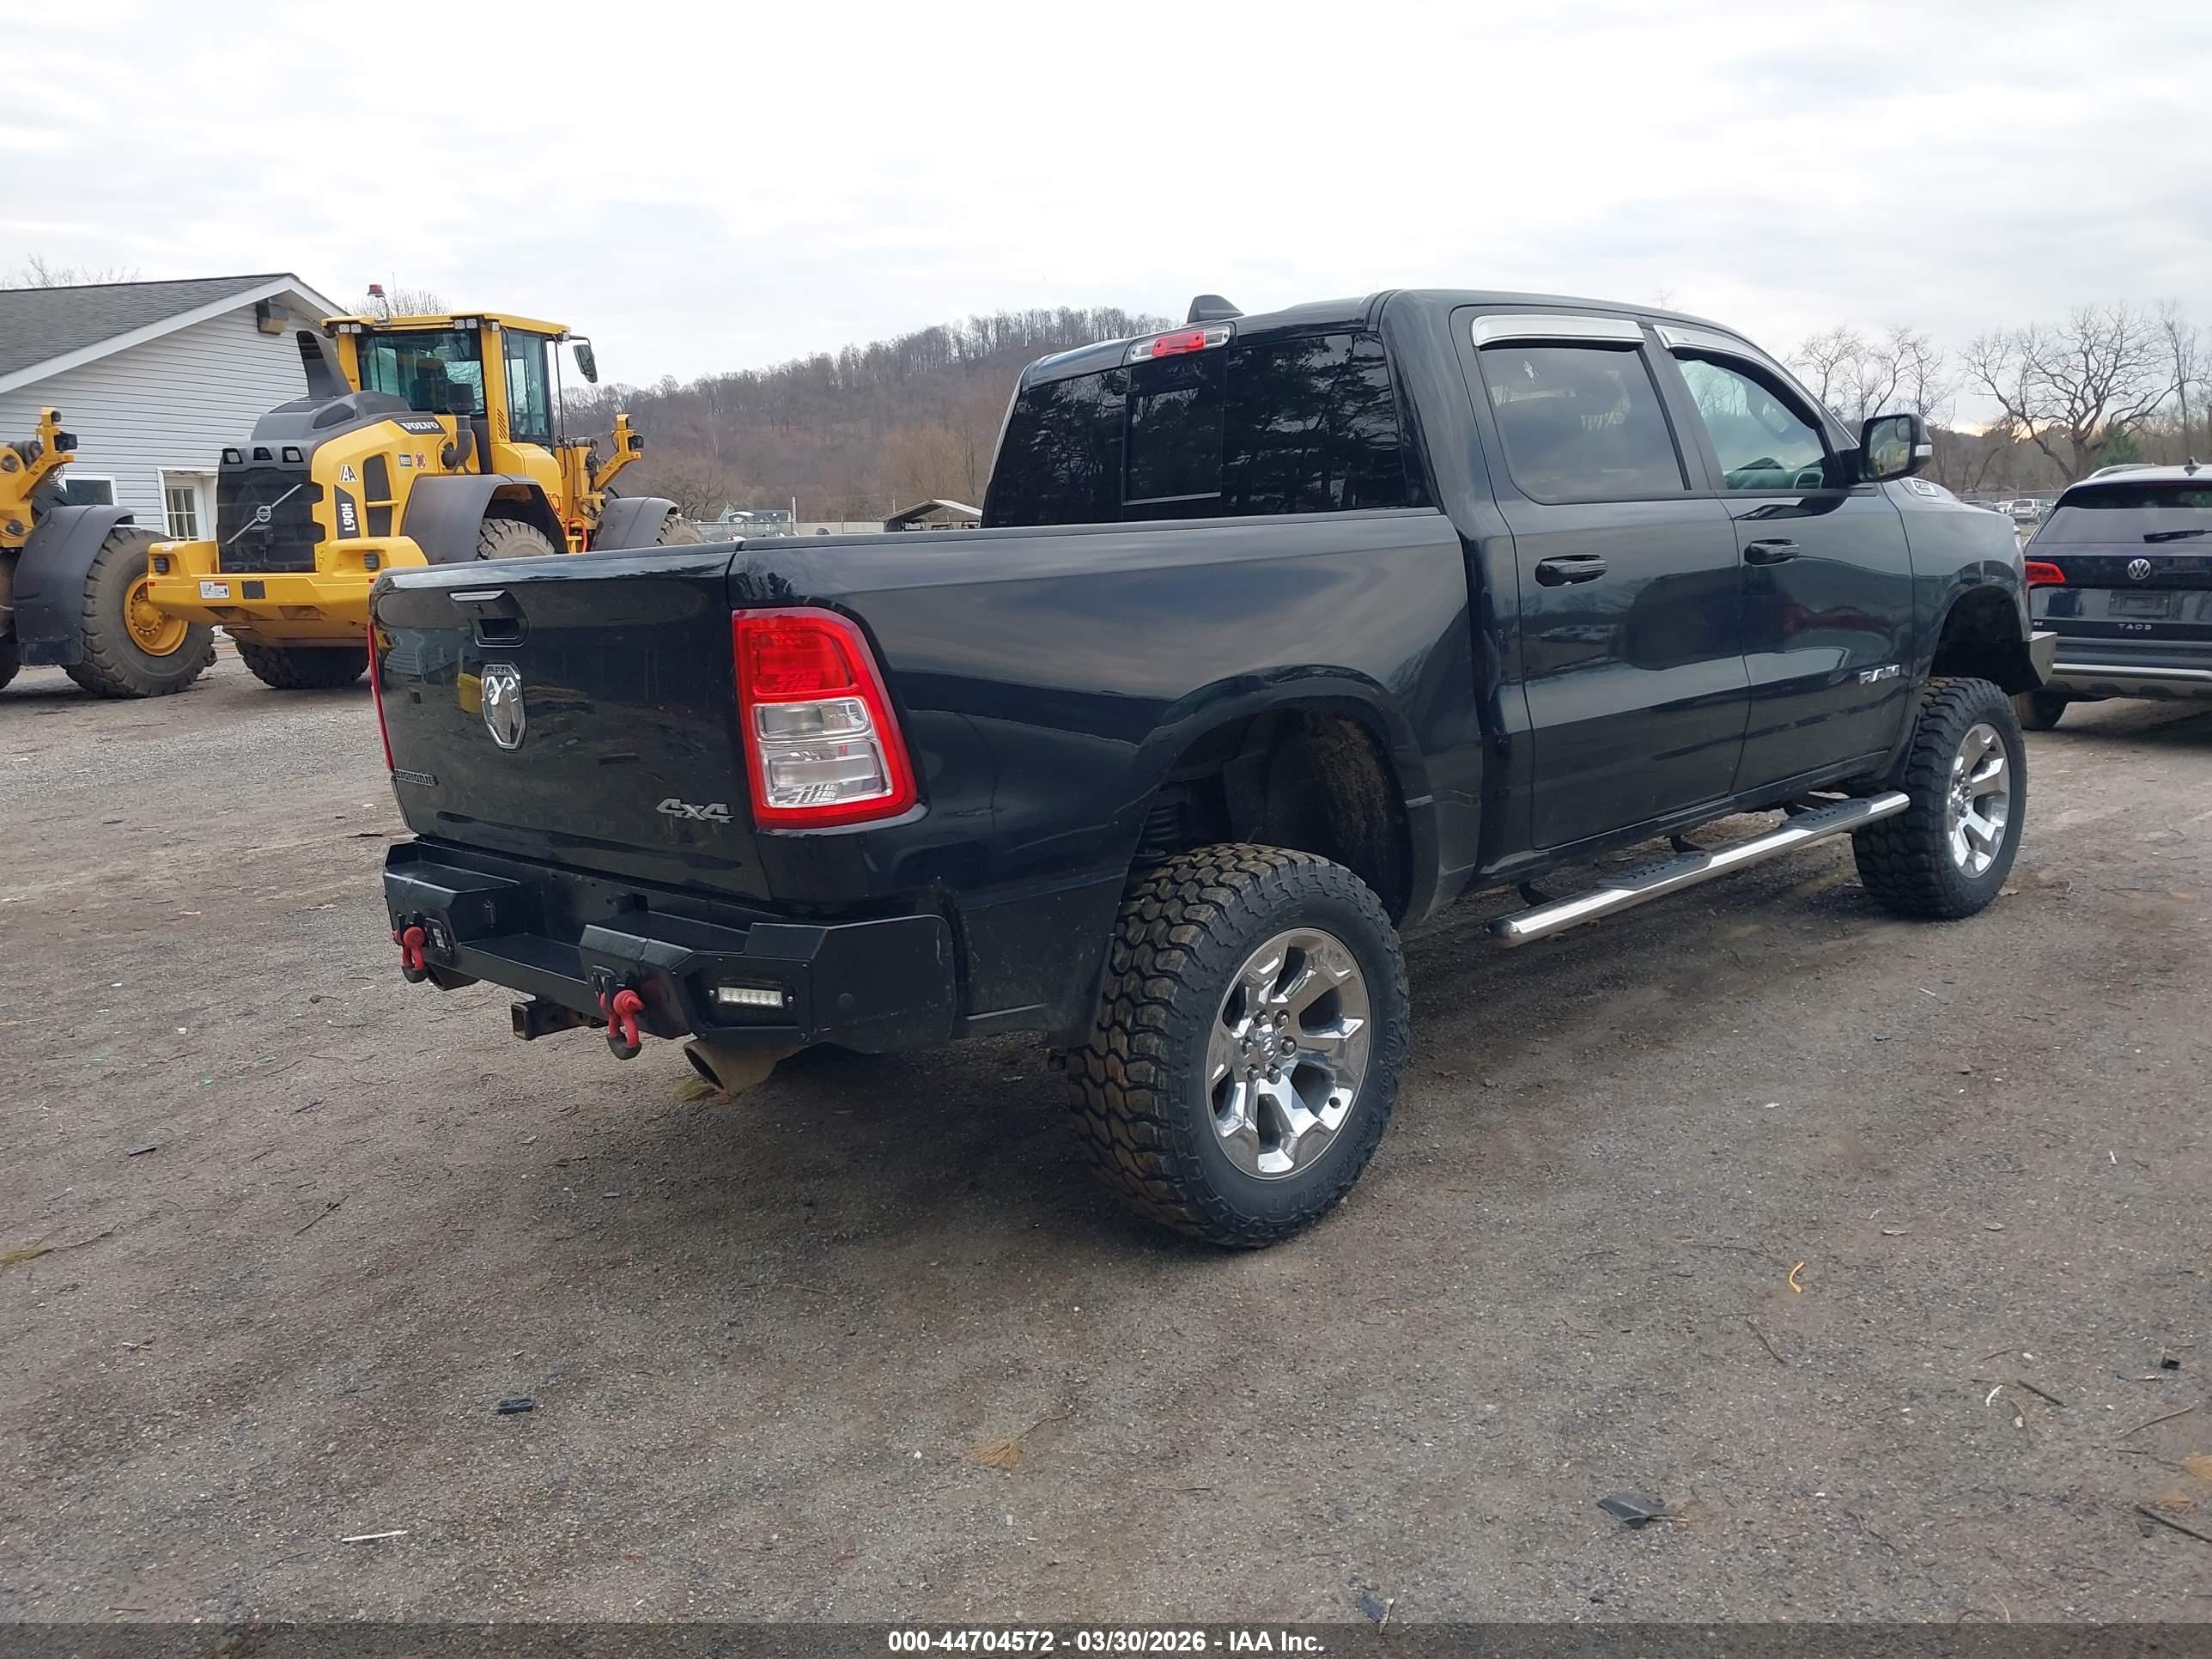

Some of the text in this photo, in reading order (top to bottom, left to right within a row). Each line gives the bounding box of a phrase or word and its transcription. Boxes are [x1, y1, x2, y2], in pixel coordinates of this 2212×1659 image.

[399, 421, 440, 430] VOLVO
[340, 502, 356, 532] L90H
[1859, 664, 1900, 685] RAM
